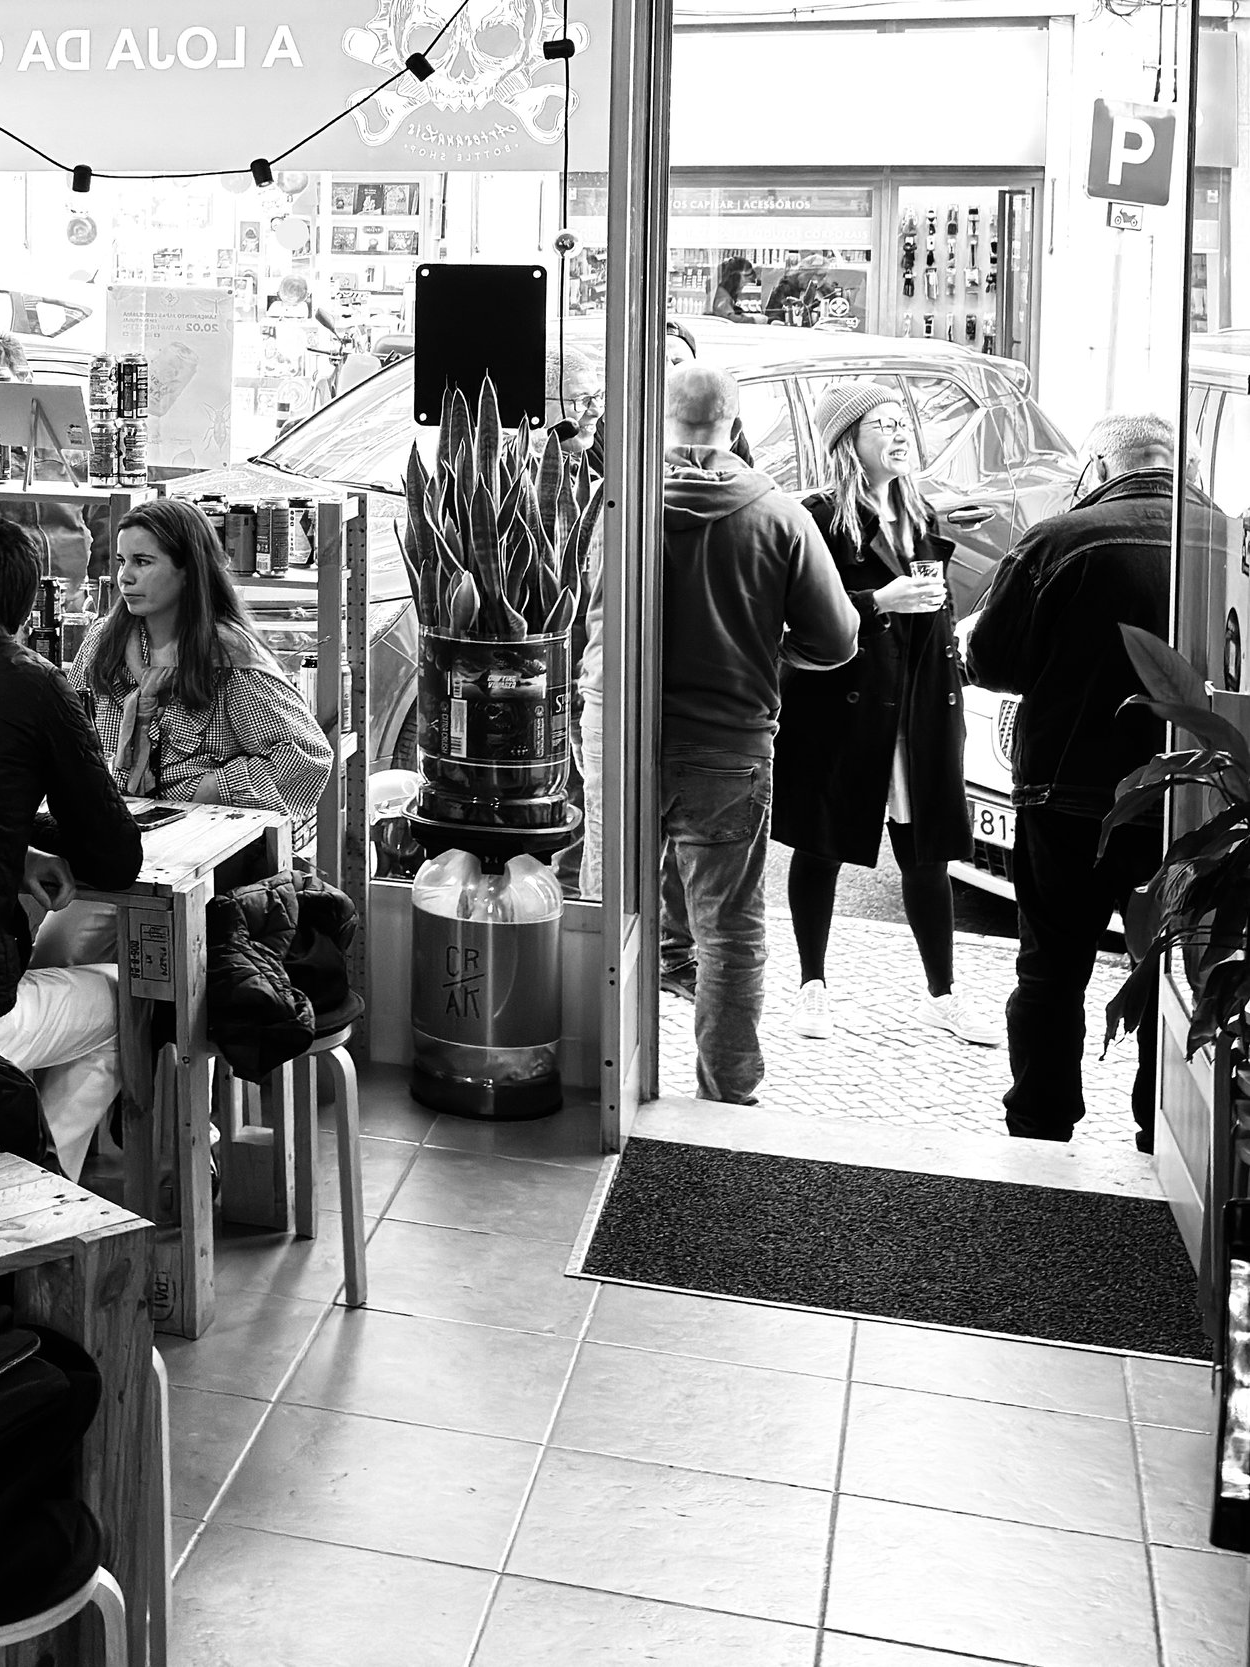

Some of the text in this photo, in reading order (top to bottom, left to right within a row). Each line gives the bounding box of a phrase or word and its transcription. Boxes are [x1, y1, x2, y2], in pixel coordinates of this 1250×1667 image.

[1107, 115, 1157, 185] P
[743, 198, 811, 210] ACESSÓRIOS
[980, 809, 1007, 841] 81
